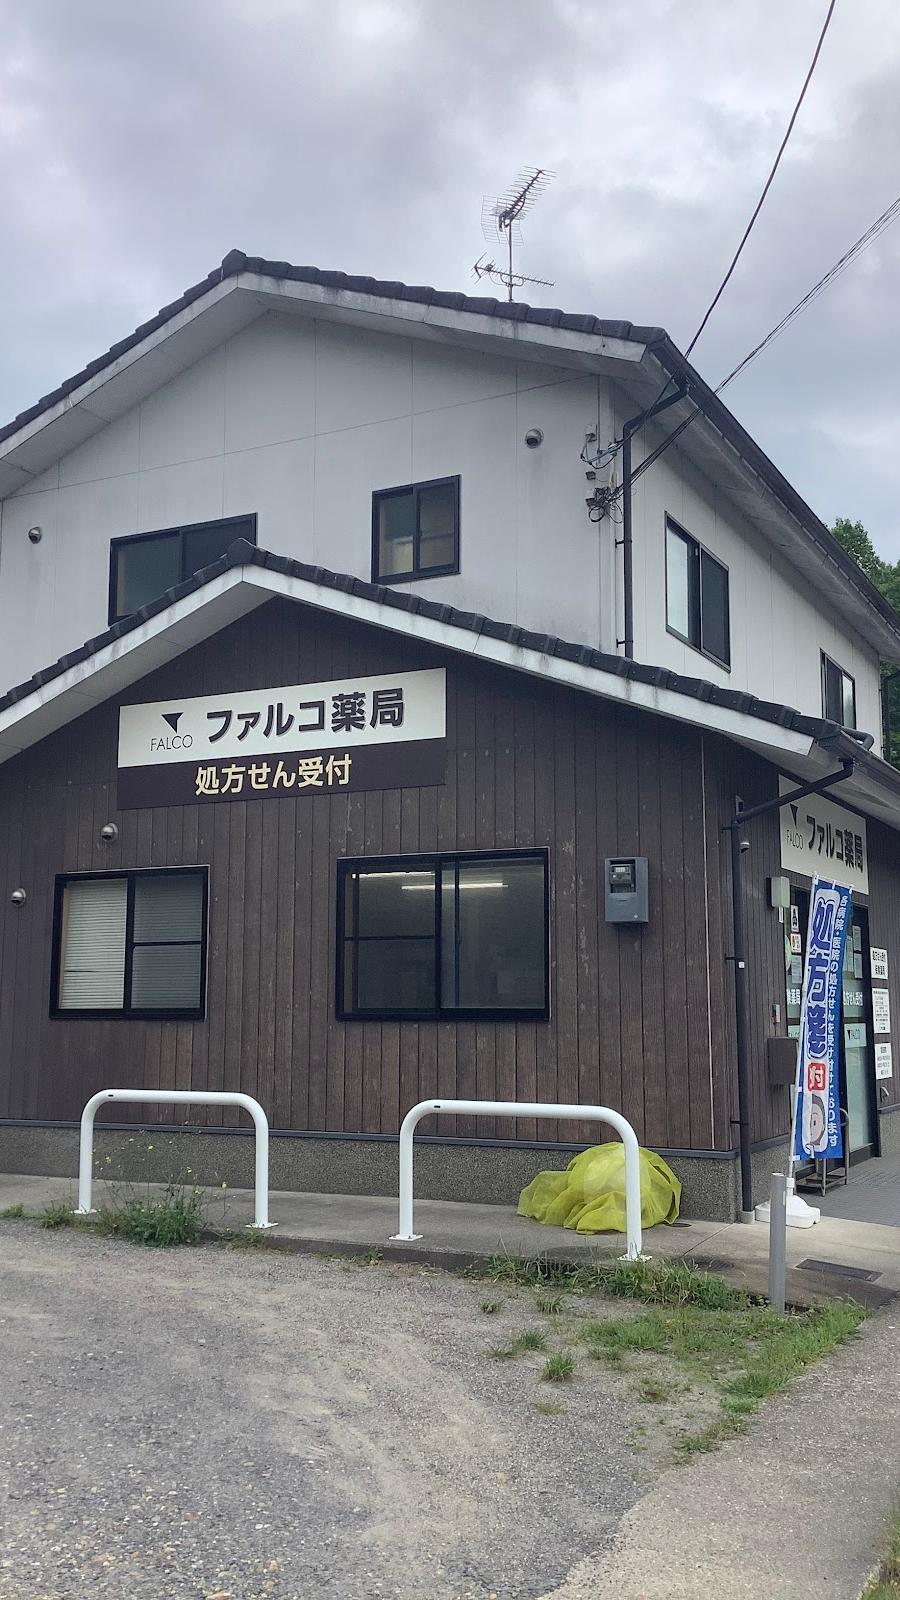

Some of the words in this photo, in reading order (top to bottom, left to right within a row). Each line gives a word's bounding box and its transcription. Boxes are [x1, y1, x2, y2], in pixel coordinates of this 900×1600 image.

[206, 687, 404, 744] ファルコ薬局
[150, 734, 194, 752] FALCO
[195, 754, 352, 796] 処方せん受付
[806, 814, 864, 873] ファルコ薬局
